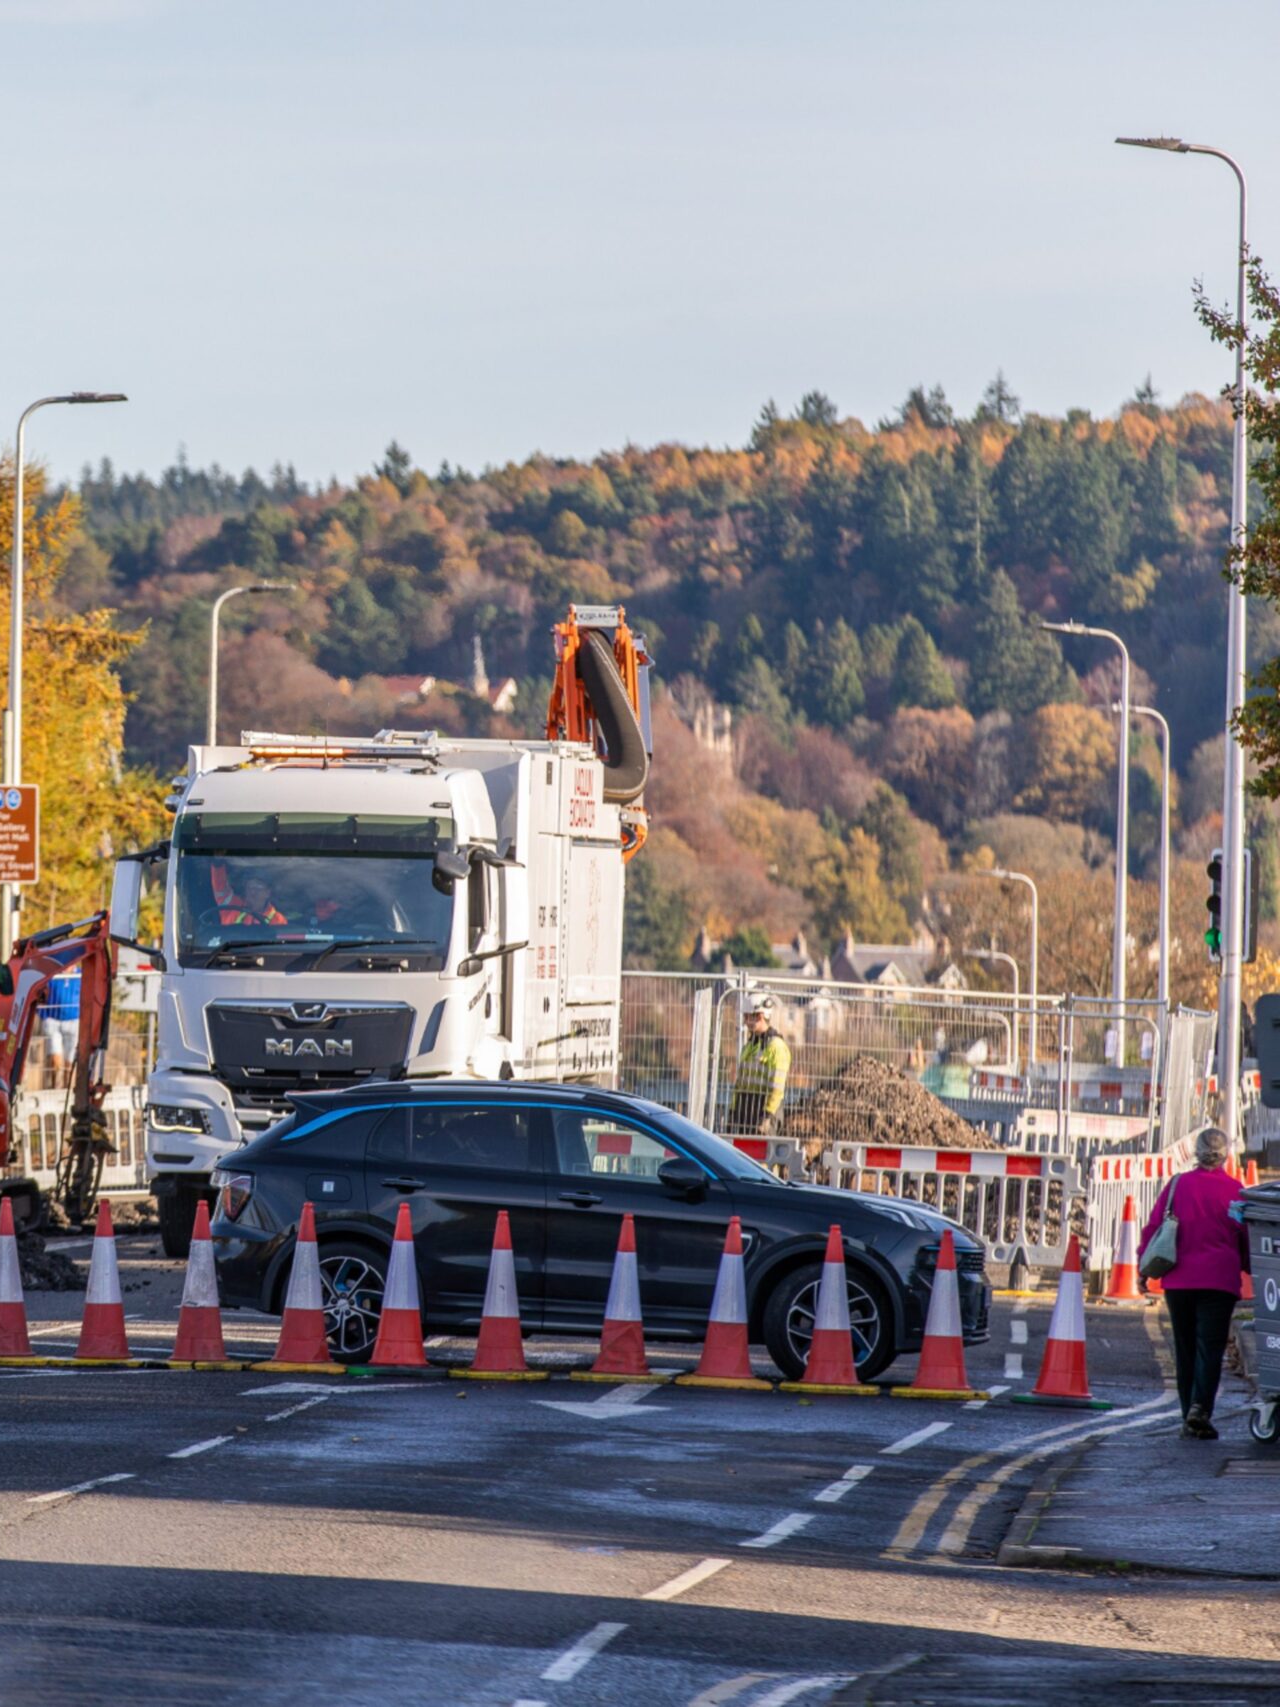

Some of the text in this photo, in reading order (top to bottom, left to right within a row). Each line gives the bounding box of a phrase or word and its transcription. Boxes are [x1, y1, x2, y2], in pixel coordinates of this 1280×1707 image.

[11, 833, 30, 842] Hall
[7, 861, 34, 871] Street
[264, 1037, 353, 1057] MAN
